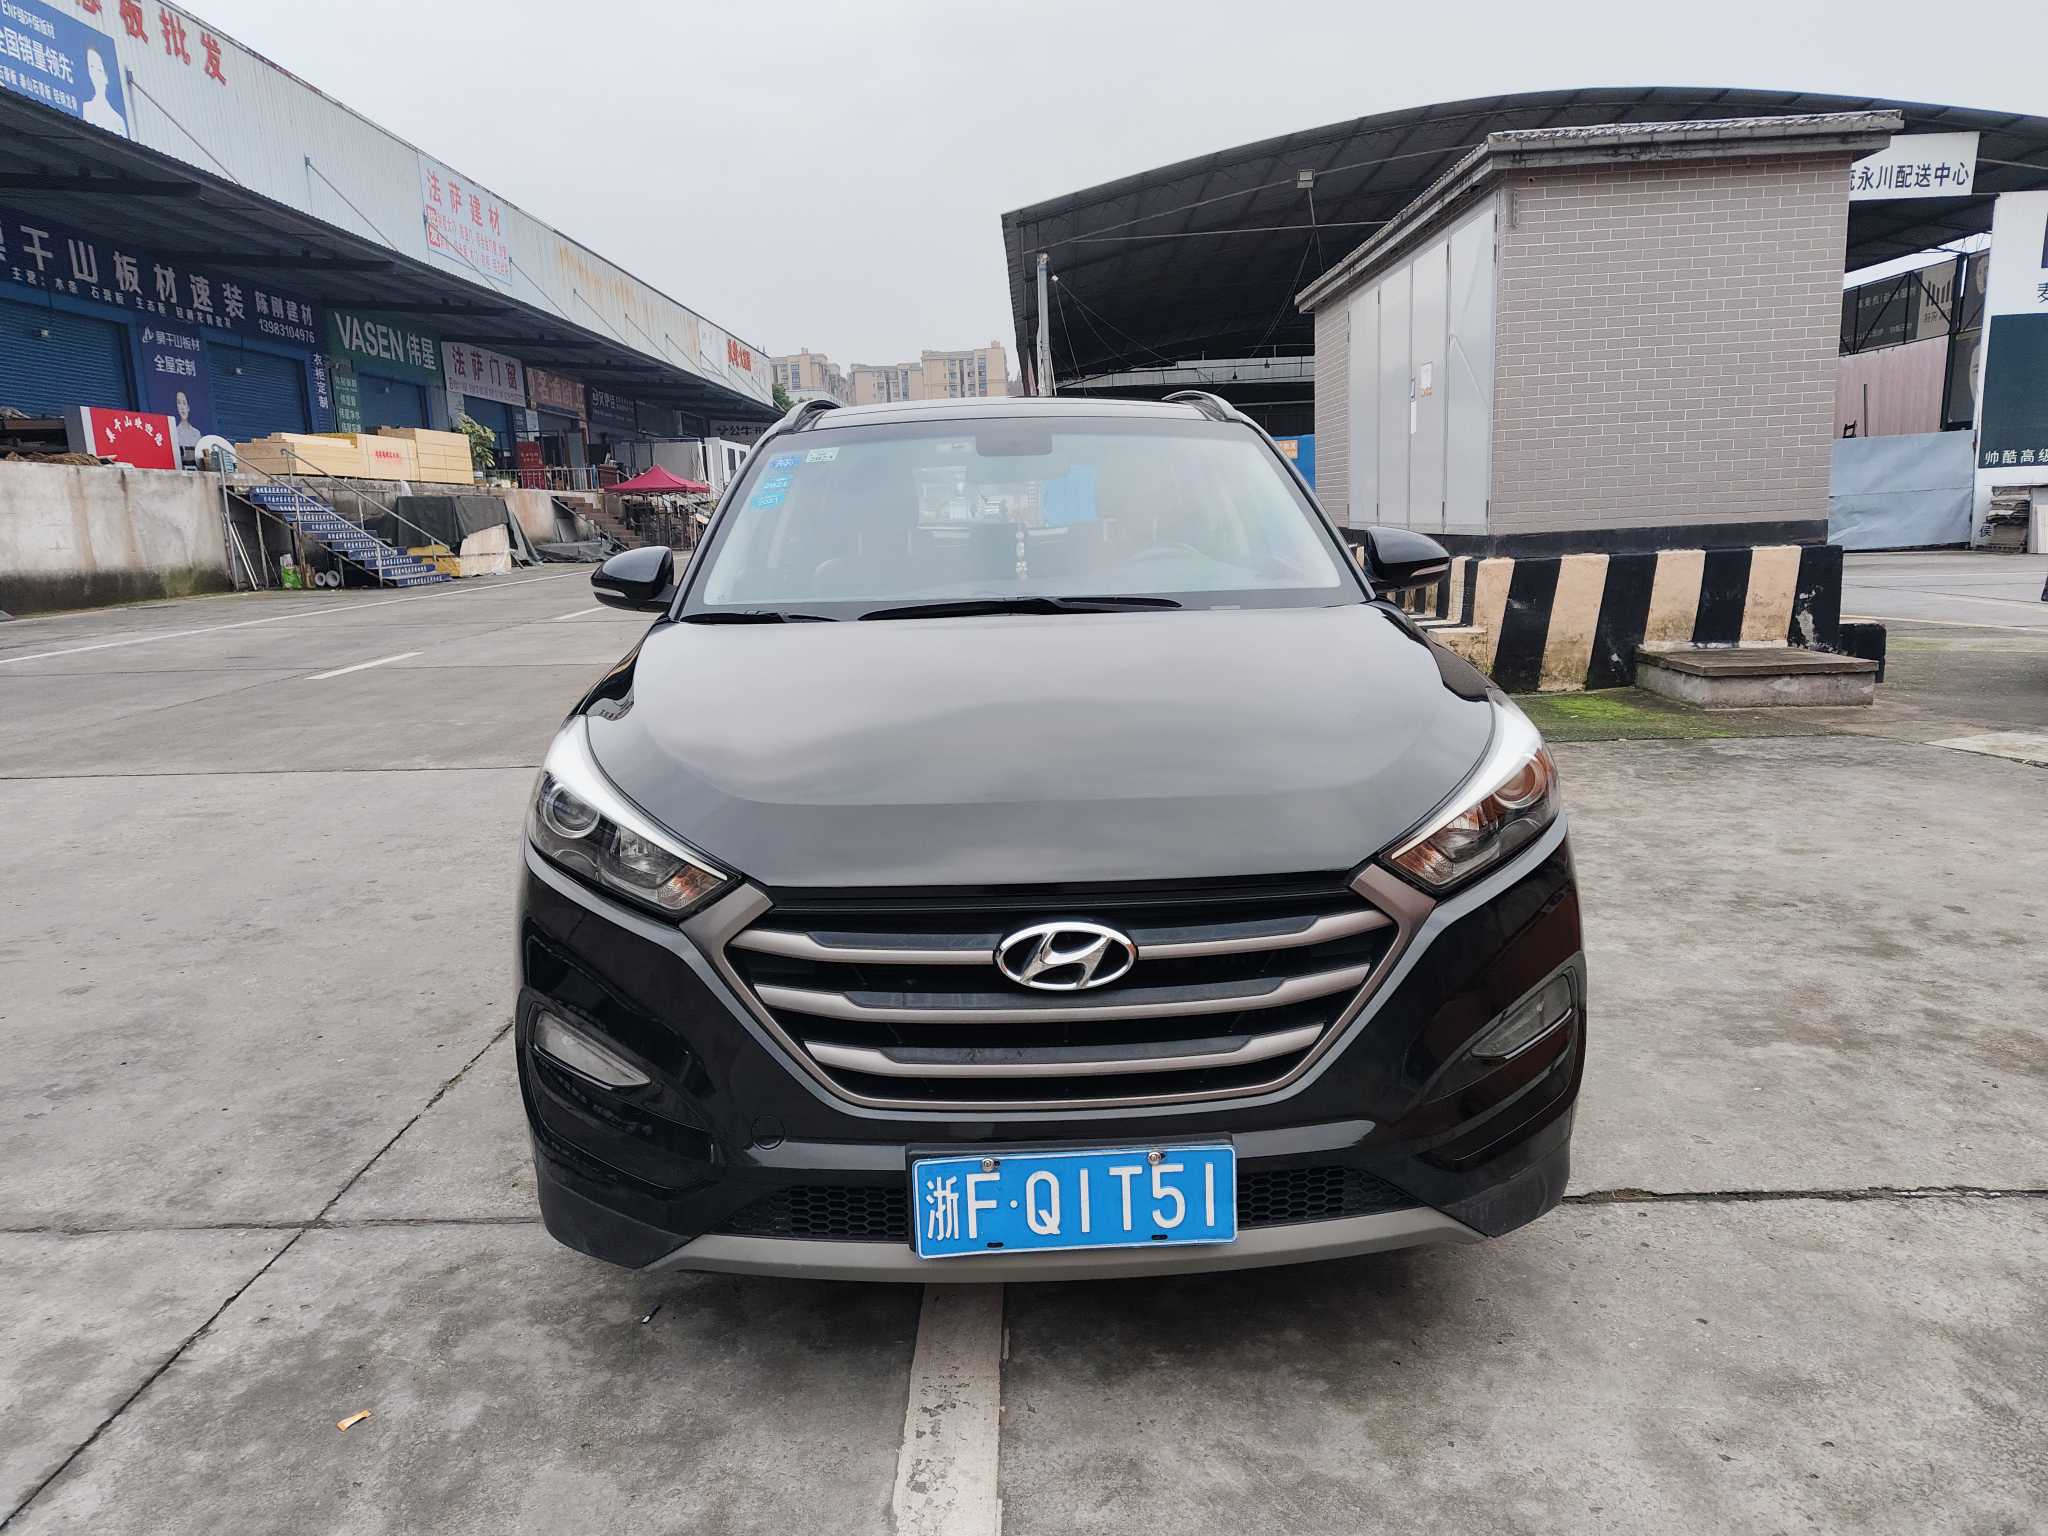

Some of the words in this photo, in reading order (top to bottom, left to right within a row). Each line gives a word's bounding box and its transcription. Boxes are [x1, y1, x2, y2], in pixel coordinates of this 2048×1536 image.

[425, 168, 500, 237] 法萨建材
[153, 354, 196, 377] 全屋定制
[155, 330, 200, 352] 莫干山板材
[334, 311, 405, 362] VASEN
[405, 331, 437, 371] 伟星
[313, 351, 329, 409] 衣柜定制
[451, 345, 518, 392] 法萨门窗
[1984, 448, 2048, 465] 帅酷高级
[926, 1162, 1215, 1241] 浙F·Q1T51
